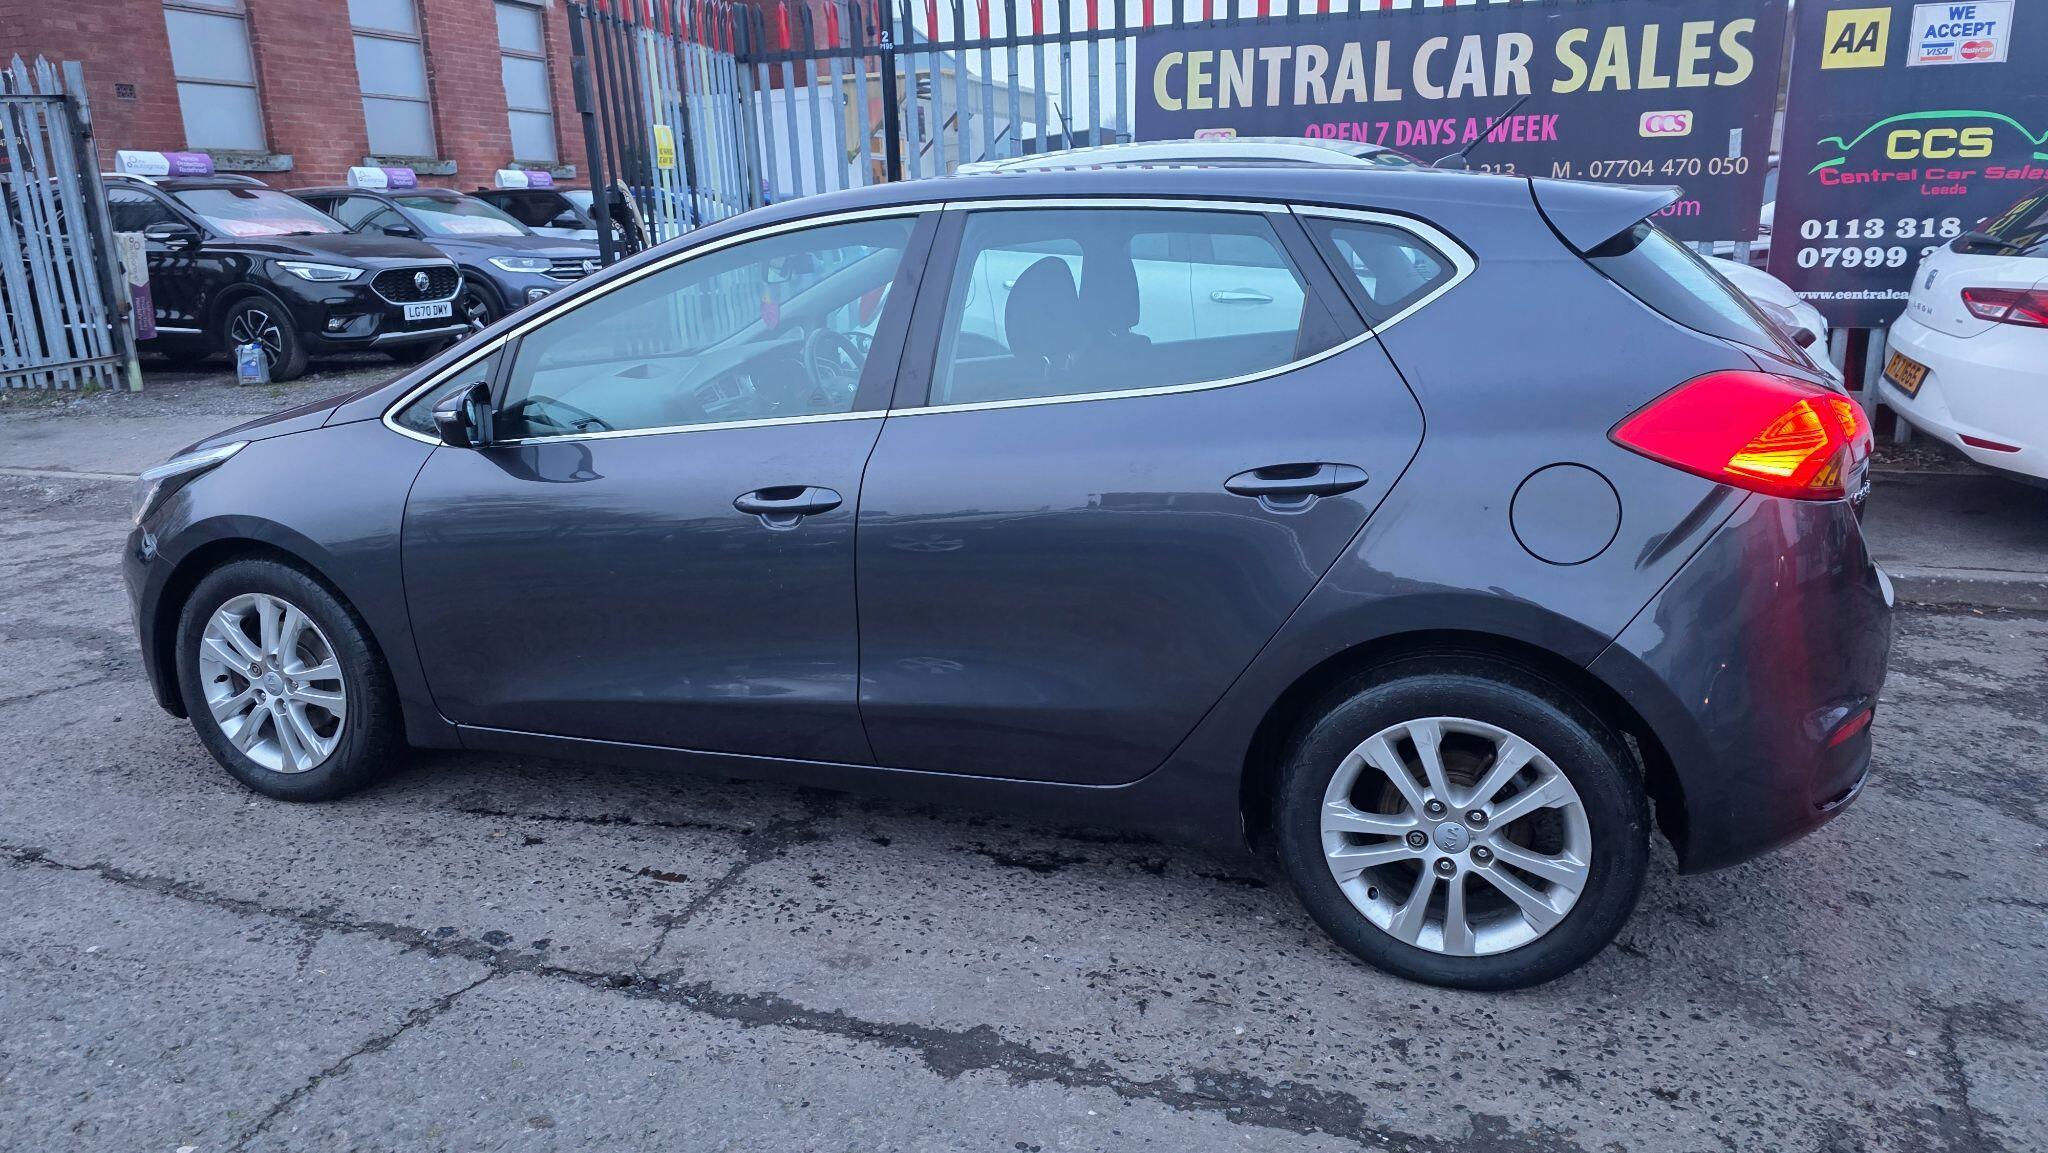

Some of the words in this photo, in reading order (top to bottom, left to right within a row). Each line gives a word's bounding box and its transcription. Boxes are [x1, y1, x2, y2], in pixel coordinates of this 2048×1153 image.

[1949, 6, 1976, 21] WE
[1829, 21, 1880, 54] AA
[1924, 21, 1996, 39] ACCEPT
[1926, 48, 1949, 56] VISA
[1153, 40, 1402, 111] CENTRAL
[1412, 32, 1532, 100] CAR
[1551, 18, 1756, 94] SALES
[1375, 122, 1390, 146] 7
[1395, 118, 1456, 147] DAYS
[1462, 118, 1478, 144] A
[1486, 114, 1560, 143] WEEK
[1645, 114, 1688, 133] CCS
[1886, 127, 1994, 160] CCS
[1552, 162, 1571, 178] M
[1589, 159, 1654, 178] 07704
[1661, 158, 1701, 176] 470
[1708, 157, 1749, 175] 050
[1820, 168, 1917, 185] Central
[1925, 168, 1976, 180] Car
[1921, 184, 1967, 195] Leeds
[1800, 218, 1885, 239] 0113
[1896, 217, 1961, 238] 318
[1797, 247, 1907, 268] 07999
[408, 305, 432, 318] LG70
